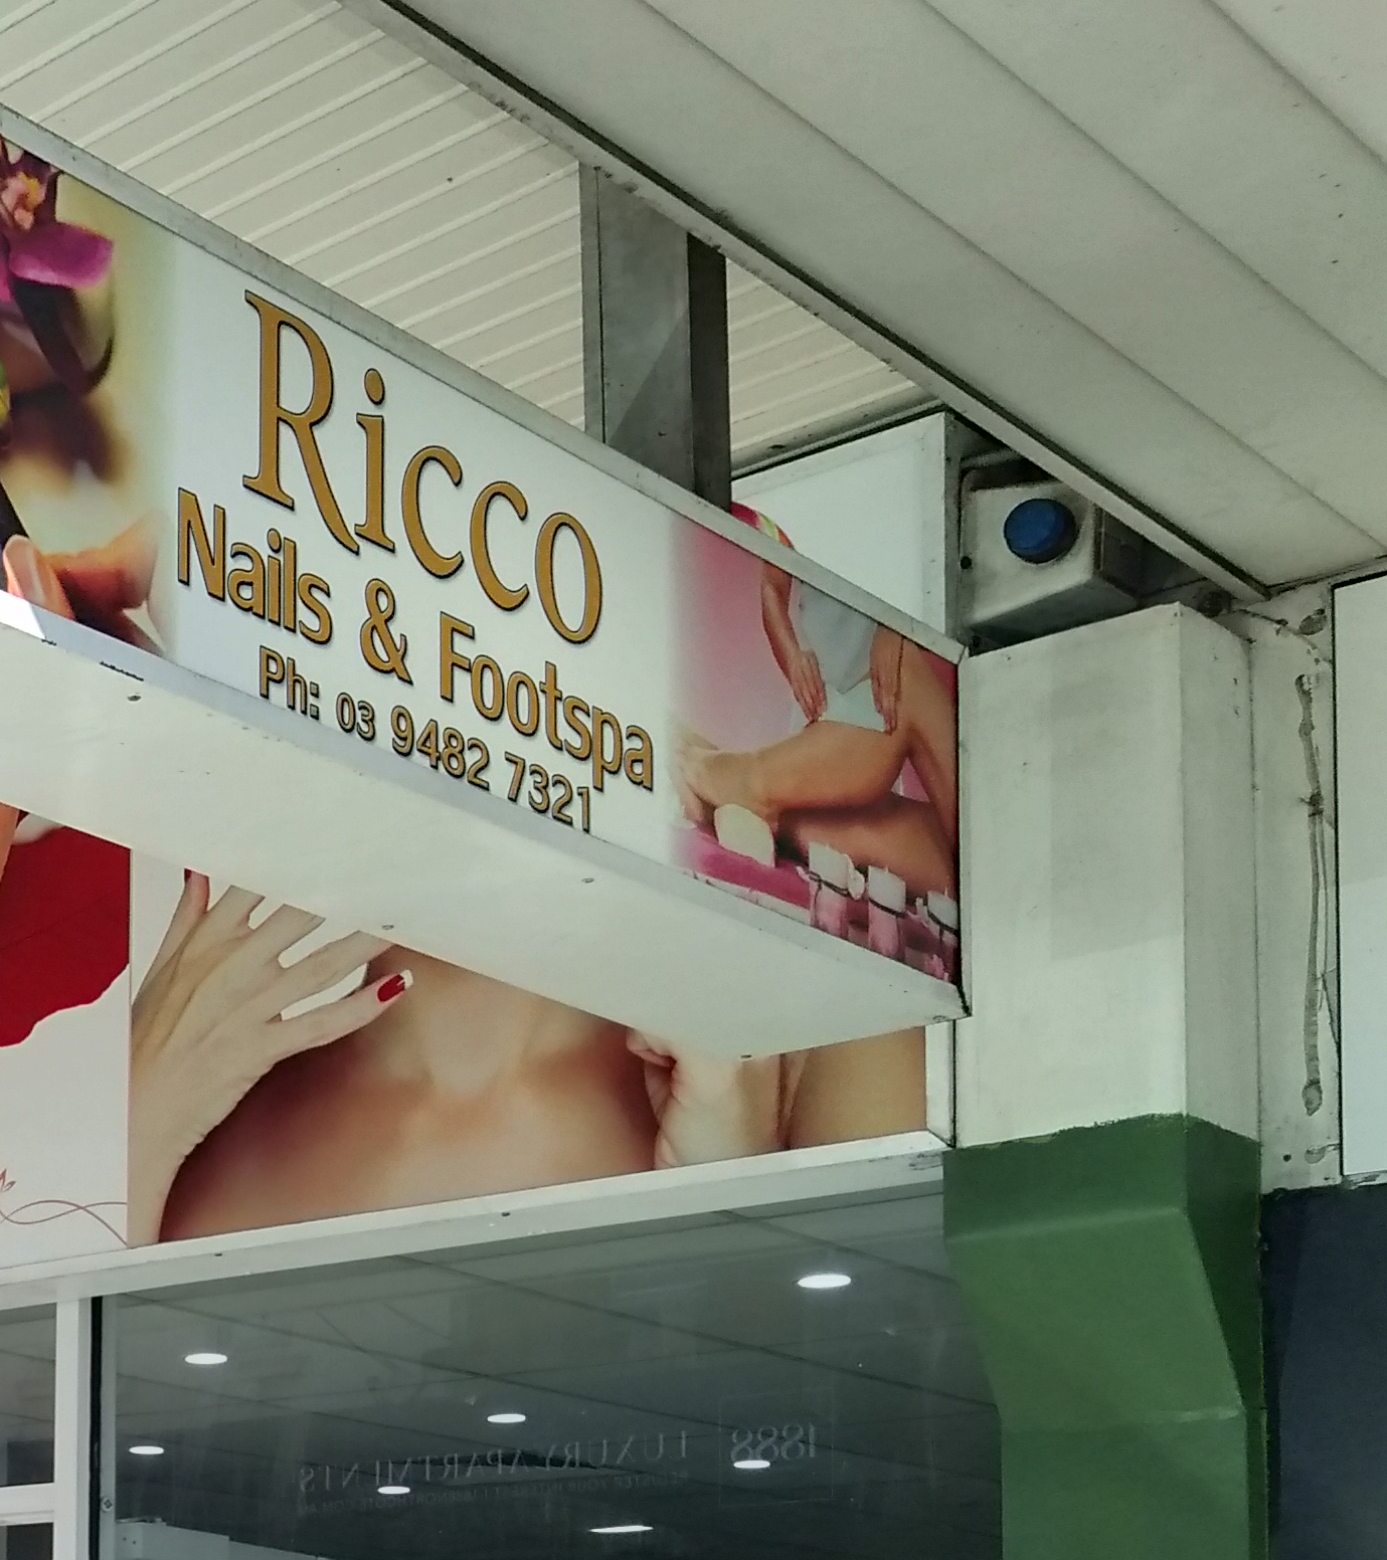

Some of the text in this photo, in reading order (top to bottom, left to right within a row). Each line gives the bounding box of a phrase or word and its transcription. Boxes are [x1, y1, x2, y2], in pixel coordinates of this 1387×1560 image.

[243, 290, 604, 644] Ricco
[177, 486, 655, 791] Nails & Footspa
[258, 645, 594, 834] Ph: 03 9482 7321
